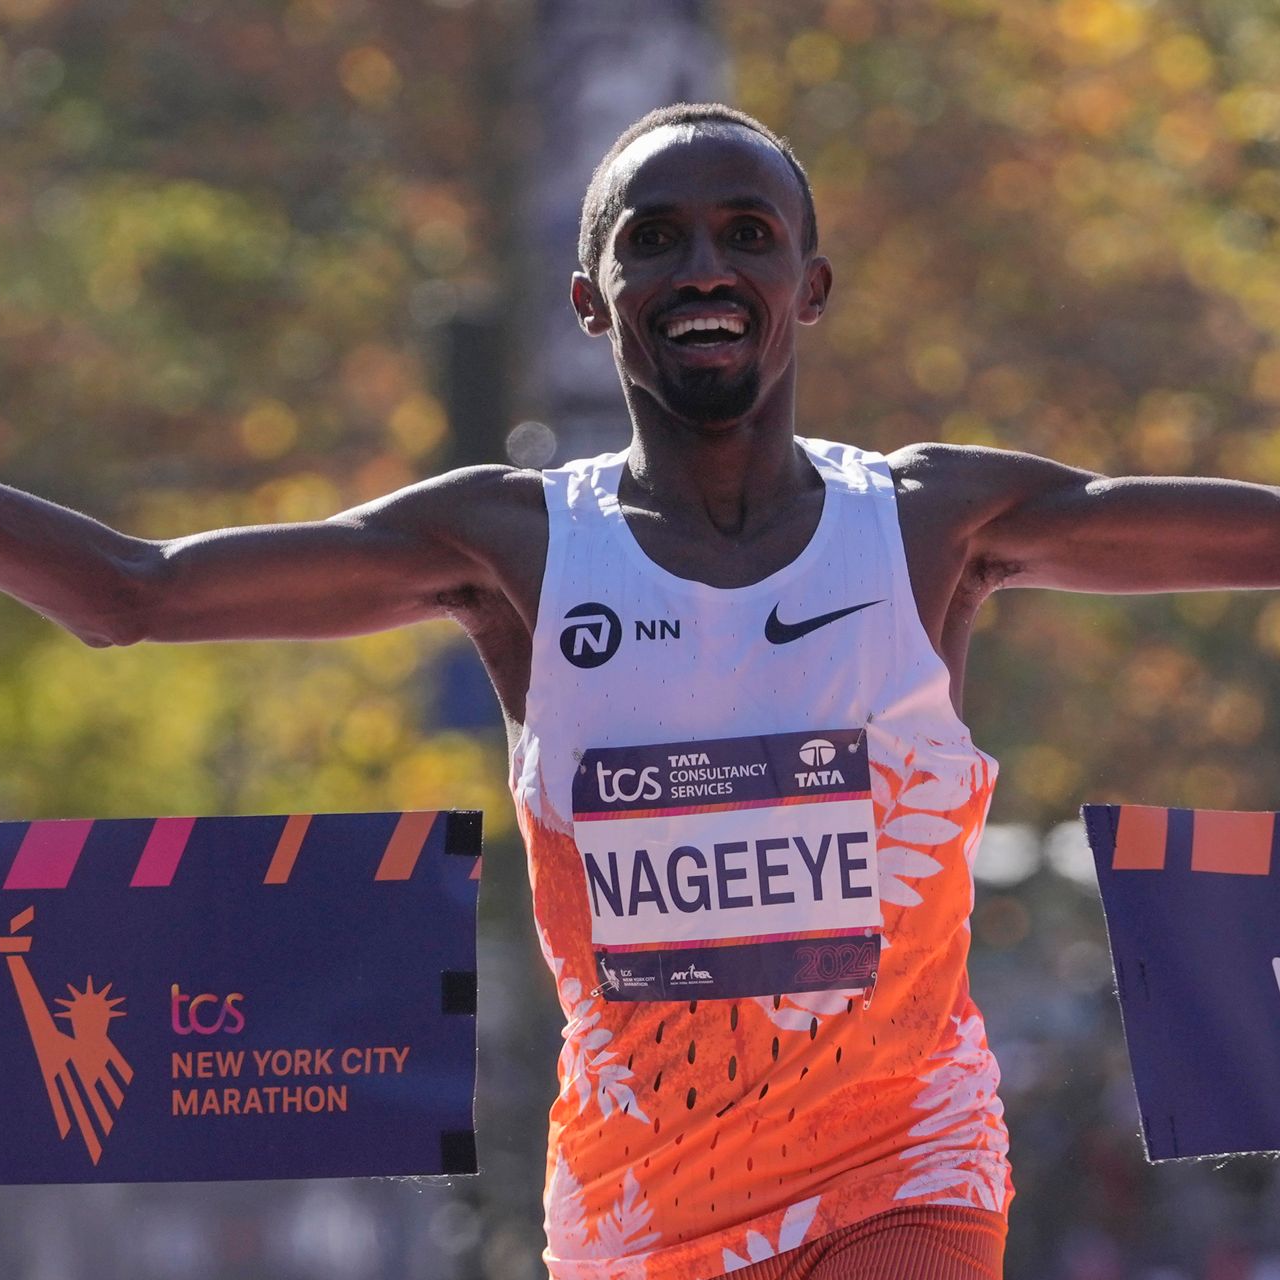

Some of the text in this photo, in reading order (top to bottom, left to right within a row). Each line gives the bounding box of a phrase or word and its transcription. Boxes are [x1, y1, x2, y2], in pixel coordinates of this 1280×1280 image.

[634, 619, 681, 641] NN
[668, 753, 710, 767] TATA
[669, 763, 768, 783] CONSULTANCY
[596, 760, 663, 803] tcs
[670, 782, 733, 798] SERVICES
[794, 770, 845, 788] TATA
[585, 832, 872, 917] NAGEEYE
[793, 942, 878, 984] 2024
[170, 983, 245, 1036] tcs
[171, 1046, 410, 1079] NEW YORK CITY
[171, 1085, 348, 1116] MARATHON
